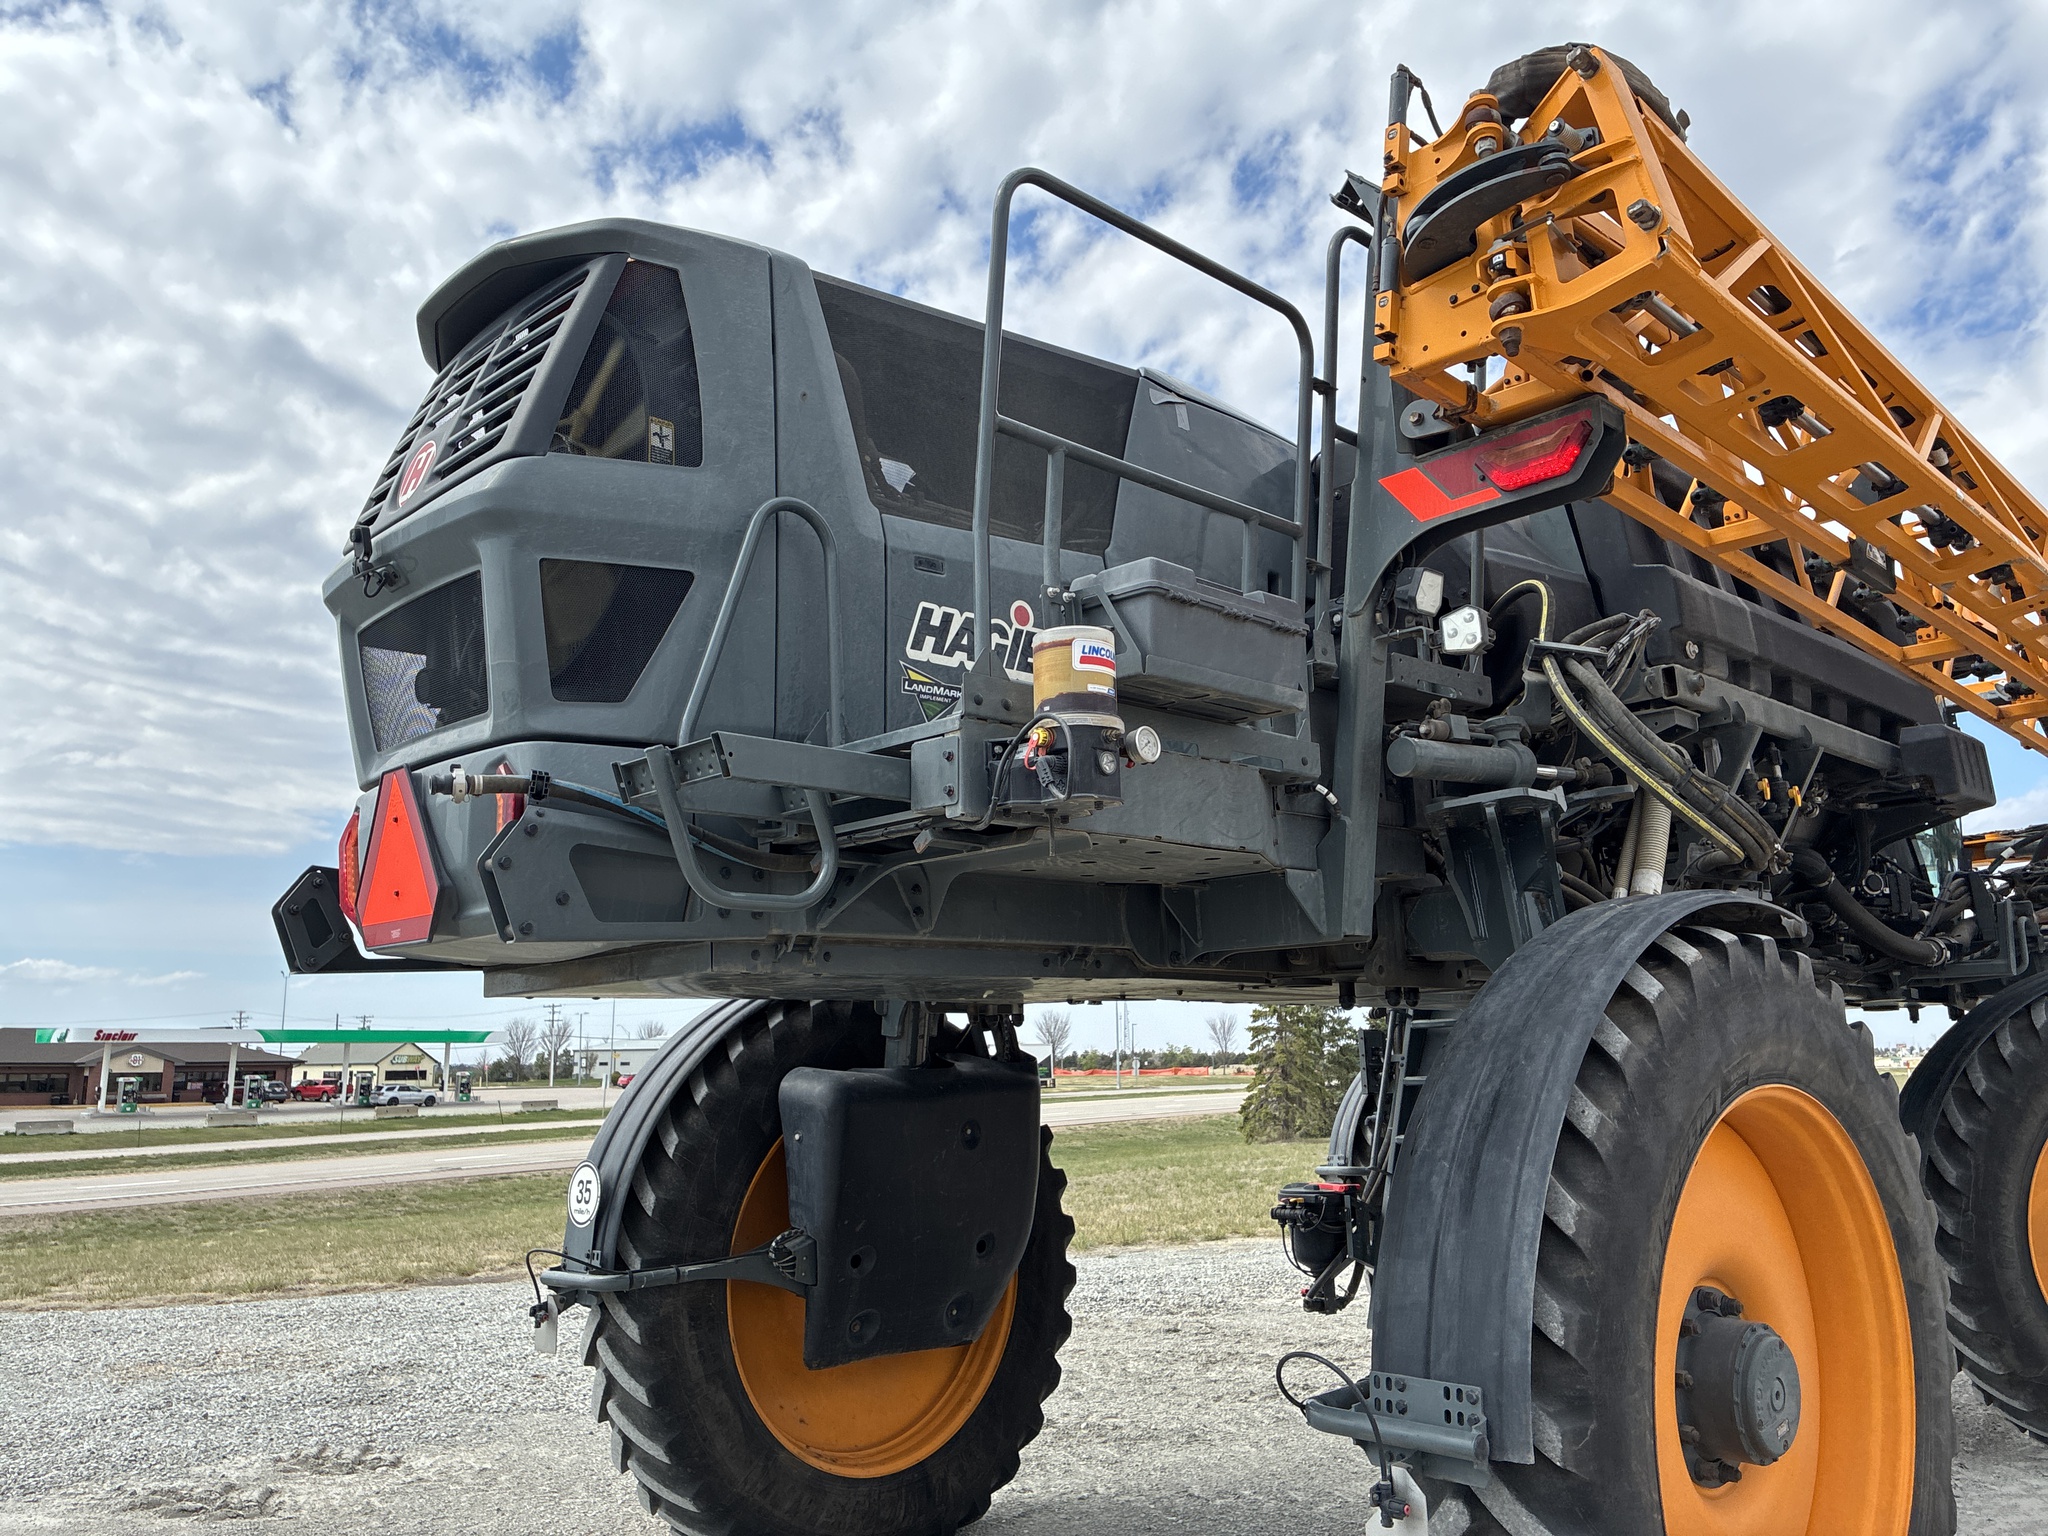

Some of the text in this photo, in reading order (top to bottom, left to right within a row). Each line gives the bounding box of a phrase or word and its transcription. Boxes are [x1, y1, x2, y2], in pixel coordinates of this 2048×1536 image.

[919, 693, 952, 704] IMPLEMENT
[94, 1029, 138, 1041] Sinclair
[391, 1054, 425, 1065] SUBWAY
[576, 1179, 592, 1205] 35
[573, 1207, 591, 1216] mile/h
